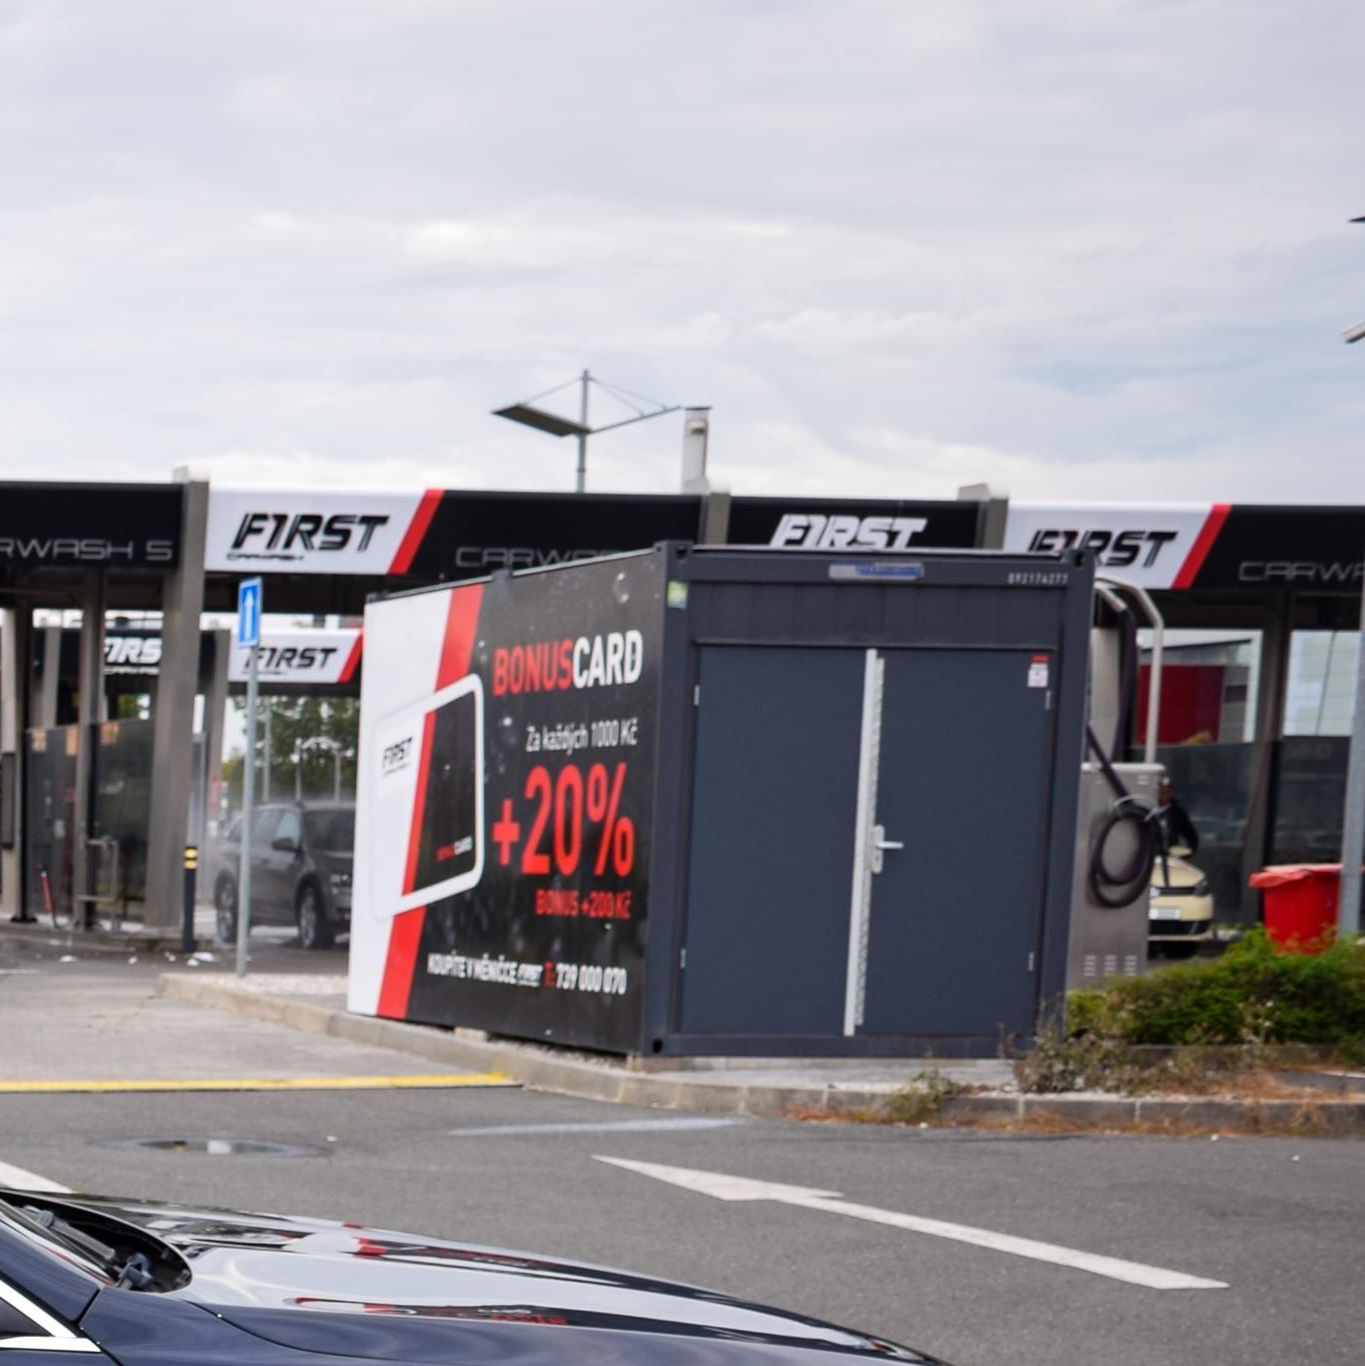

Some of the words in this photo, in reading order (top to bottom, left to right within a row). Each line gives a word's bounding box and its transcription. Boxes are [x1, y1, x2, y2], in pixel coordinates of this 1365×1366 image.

[591, 719, 619, 748] 1000
[620, 716, 639, 746] Kč
[492, 761, 635, 877] +20%
[535, 889, 579, 916] BONUS
[580, 891, 614, 917] +200
[579, 964, 603, 992] 000
[603, 966, 628, 995] 070
